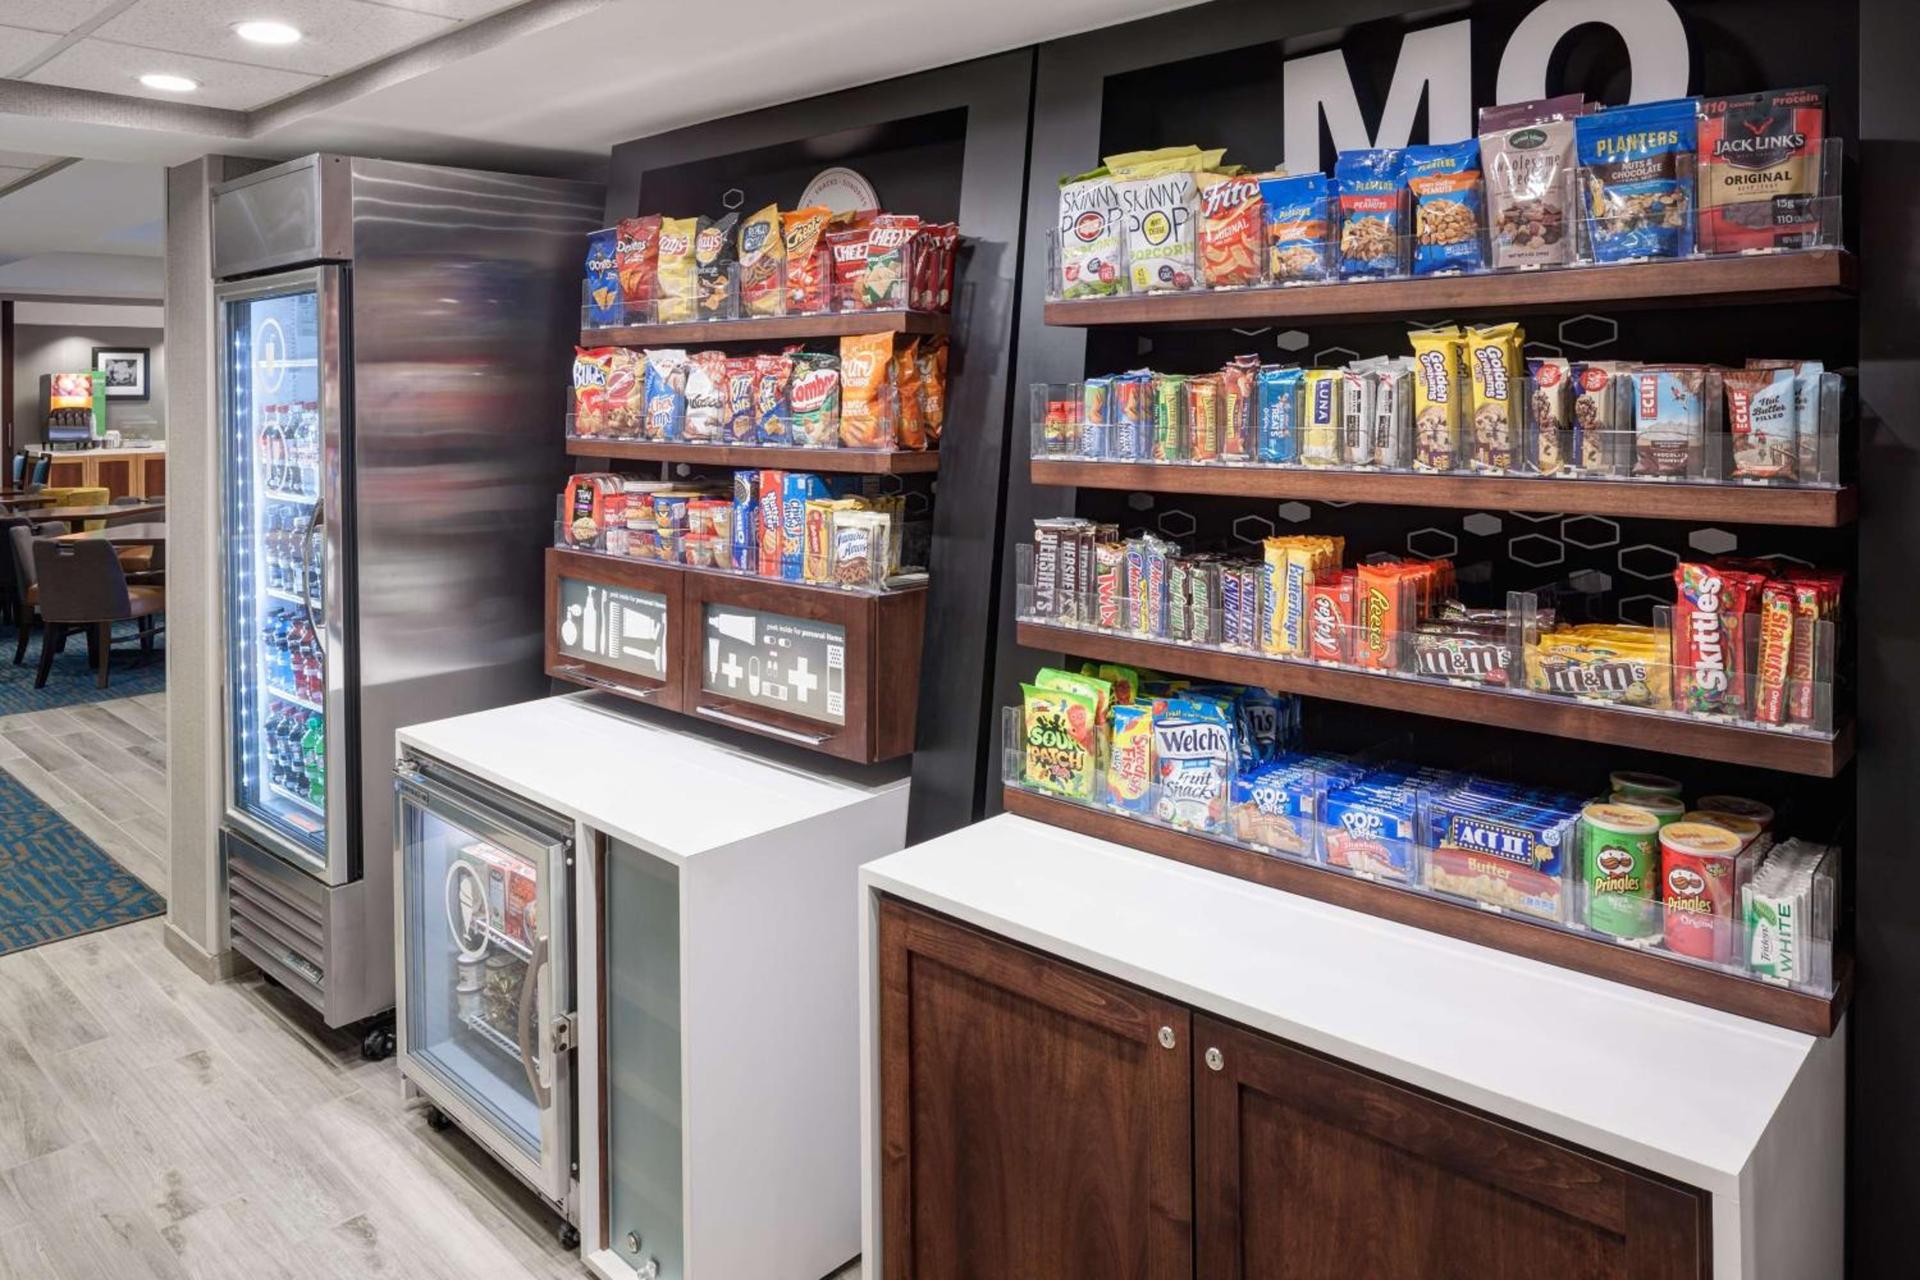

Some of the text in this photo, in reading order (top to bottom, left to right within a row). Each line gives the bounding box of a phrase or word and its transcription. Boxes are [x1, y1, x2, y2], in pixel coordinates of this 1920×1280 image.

[1704, 101, 1728, 114] 110
[1596, 131, 1679, 158] PLANTERS
[1713, 139, 1753, 156] JACK
[1755, 133, 1805, 150] LINK'S
[1611, 163, 1663, 180] CHOCOLATE
[1622, 160, 1646, 170] NUTS
[1724, 171, 1793, 186] ORIGINAL
[1202, 178, 1260, 221] Frito
[1776, 199, 1795, 209] 15g
[1776, 215, 1793, 224] 110
[1420, 354, 1438, 401] Grahams
[1430, 351, 1448, 403] Golden
[1475, 349, 1496, 398] Grahams
[1486, 345, 1508, 401] Golden
[1318, 380, 1330, 421] LUNA
[1643, 376, 1656, 414] CLIF
[1735, 392, 1748, 423] CLIF
[1752, 403, 1787, 417] Butter
[1758, 395, 1781, 408] Nut
[1270, 403, 1279, 437] TREATS
[1755, 412, 1785, 423] FILLED
[1036, 534, 1057, 612] HERSHEY'S
[1098, 567, 1119, 627] TWIX
[1224, 574, 1240, 643] SNICKERS
[1242, 576, 1254, 643] SNICKERS
[1264, 562, 1274, 646] Butterfinger
[1287, 563, 1304, 648] Butterfinger
[1417, 646, 1512, 676] m&m's
[1543, 661, 1647, 693] m&m's
[1769, 690, 1780, 722] Original
[1800, 685, 1811, 718] Original
[1159, 728, 1227, 754] Welch's
[1030, 747, 1084, 771] PATCH
[1120, 746, 1136, 780] Fish
[1128, 734, 1149, 795] Swedish
[1165, 782, 1217, 800] Snacks
[1178, 770, 1213, 787] Fruit
[1460, 825, 1525, 856] ACT II
[1467, 857, 1511, 880] Butter
[1595, 875, 1641, 897] Pringles
[1668, 896, 1712, 914] Pringles
[1680, 914, 1714, 929] Original
[1759, 923, 1772, 962] Trident
[1777, 902, 1793, 973] WHITE
